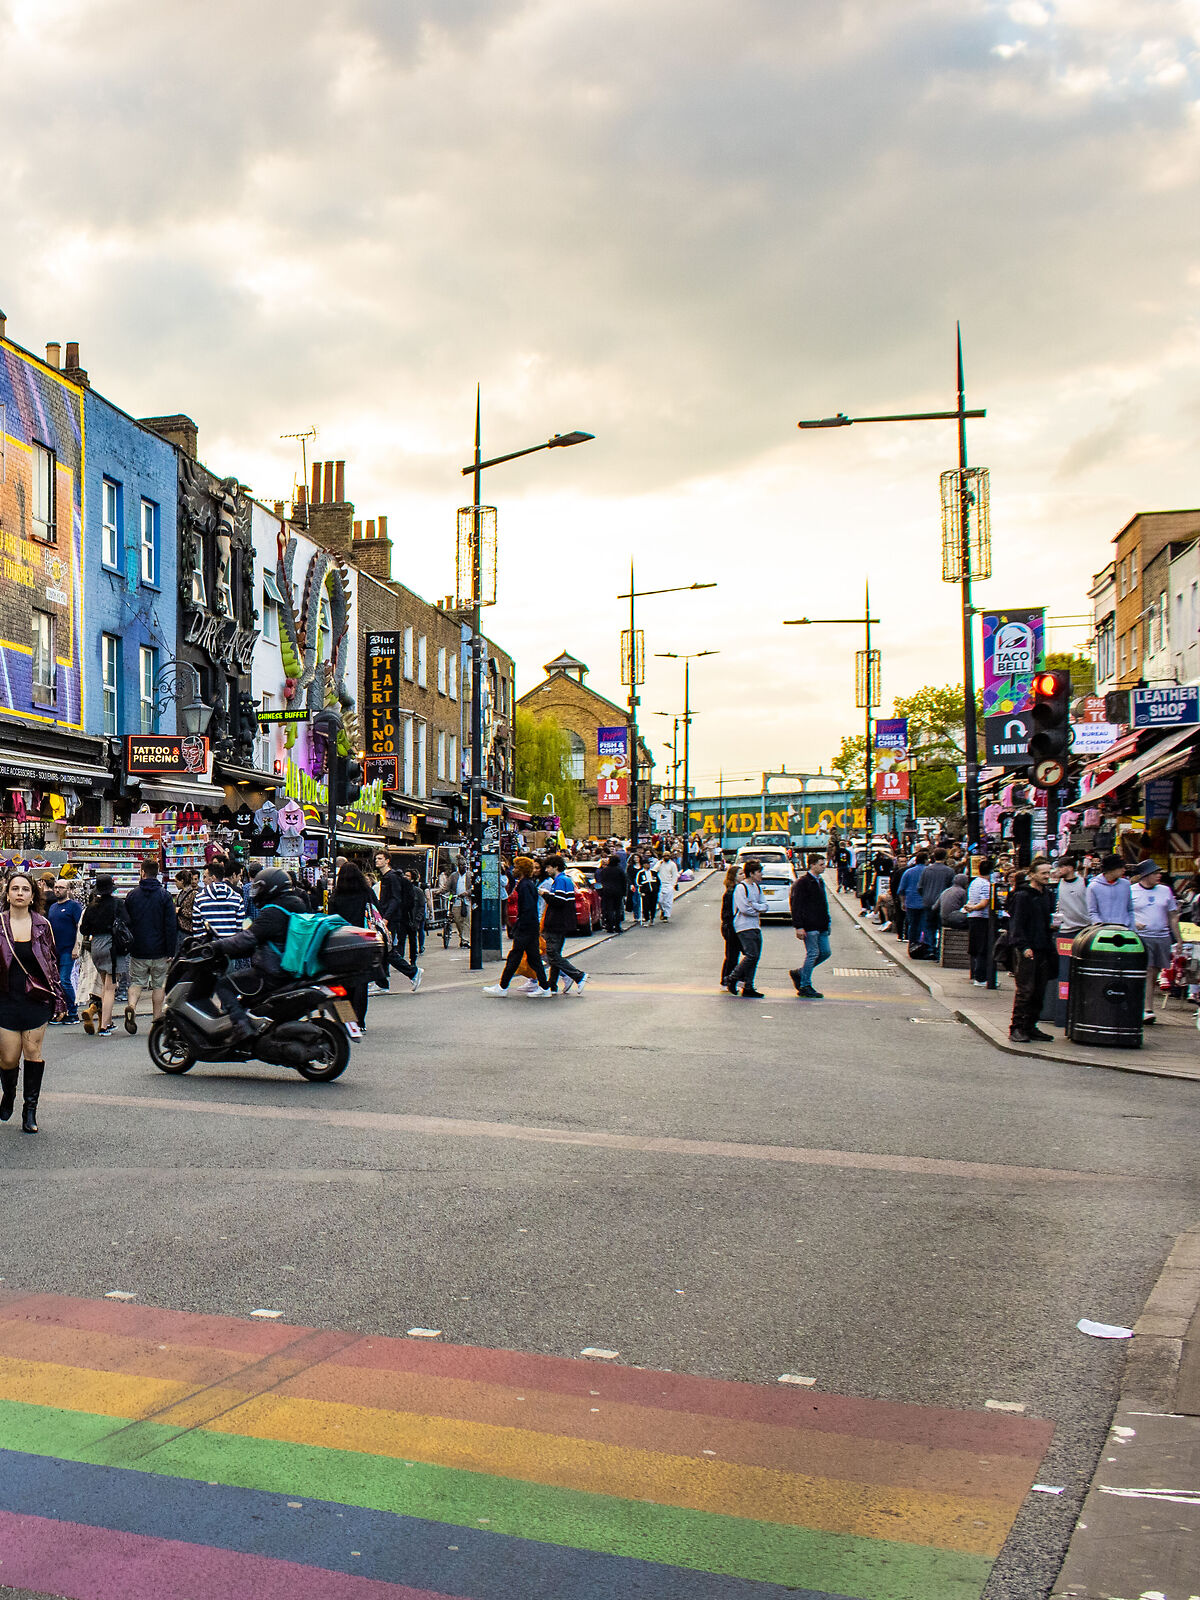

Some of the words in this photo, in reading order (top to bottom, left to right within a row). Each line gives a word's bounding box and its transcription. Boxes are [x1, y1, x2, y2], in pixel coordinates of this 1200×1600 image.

[5, 531, 18, 556] ARE
[369, 635, 395, 645] Blue
[996, 651, 1029, 663] TACO
[997, 661, 1028, 672] BELL
[1134, 687, 1198, 704] LEATHER
[372, 656, 384, 753] PIERCING
[383, 657, 394, 753] TATTOO
[1149, 703, 1188, 717] SHOP
[257, 711, 283, 720] CHINESE
[284, 710, 308, 720] BUFFET
[132, 746, 170, 755] TATTOO
[172, 747, 180, 755] &
[993, 745, 1000, 755] 5
[1000, 744, 1017, 754] MIN
[133, 754, 180, 763] PIERCING
[10, 768, 36, 779] ACCESSORIES
[319, 784, 329, 806] CA
[801, 807, 866, 835] LOCK
